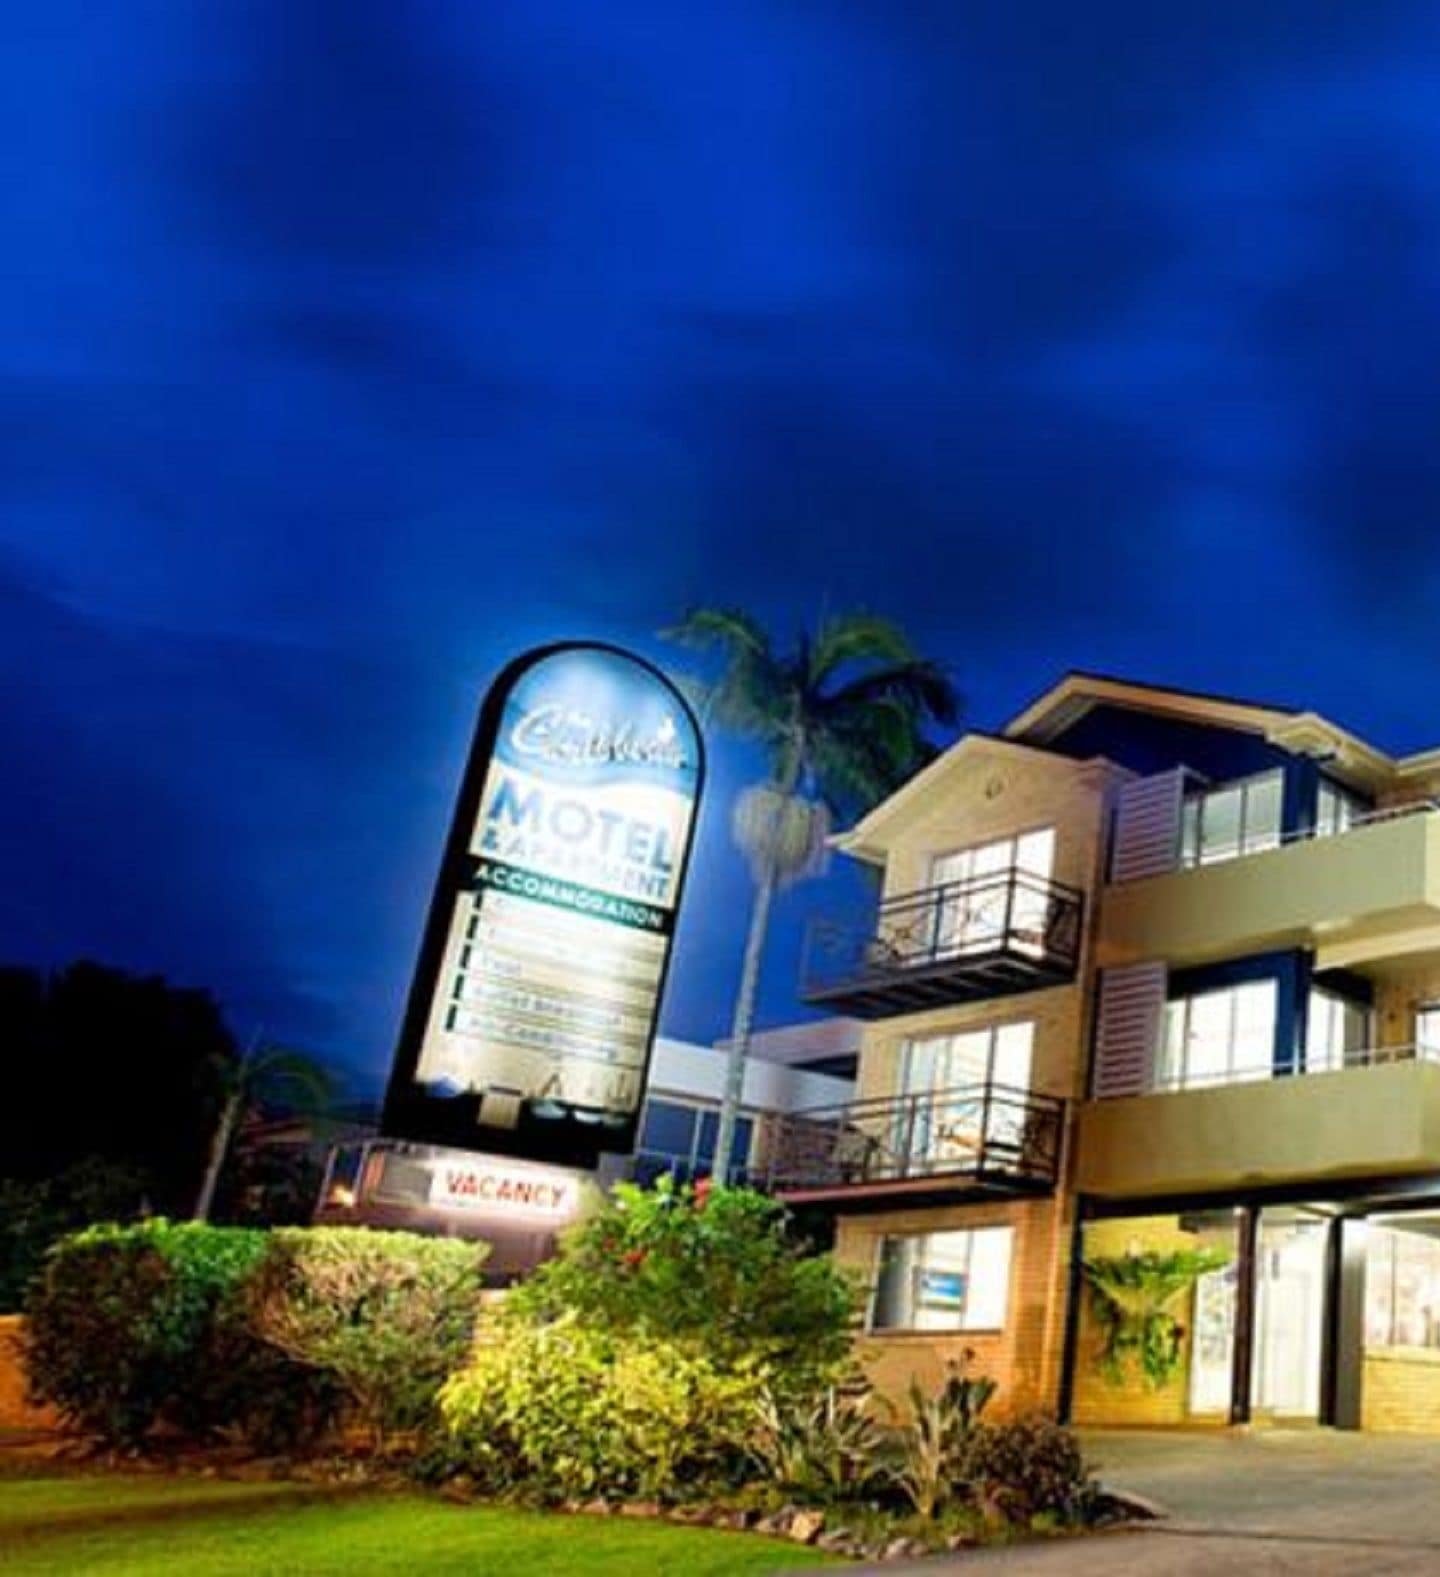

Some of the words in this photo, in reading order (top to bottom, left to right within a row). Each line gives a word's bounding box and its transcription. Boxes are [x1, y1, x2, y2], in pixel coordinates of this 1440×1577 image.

[489, 778, 672, 872] MOTEL
[474, 863, 664, 927] ACCOMMODATION
[445, 1168, 567, 1208] VACANCY
